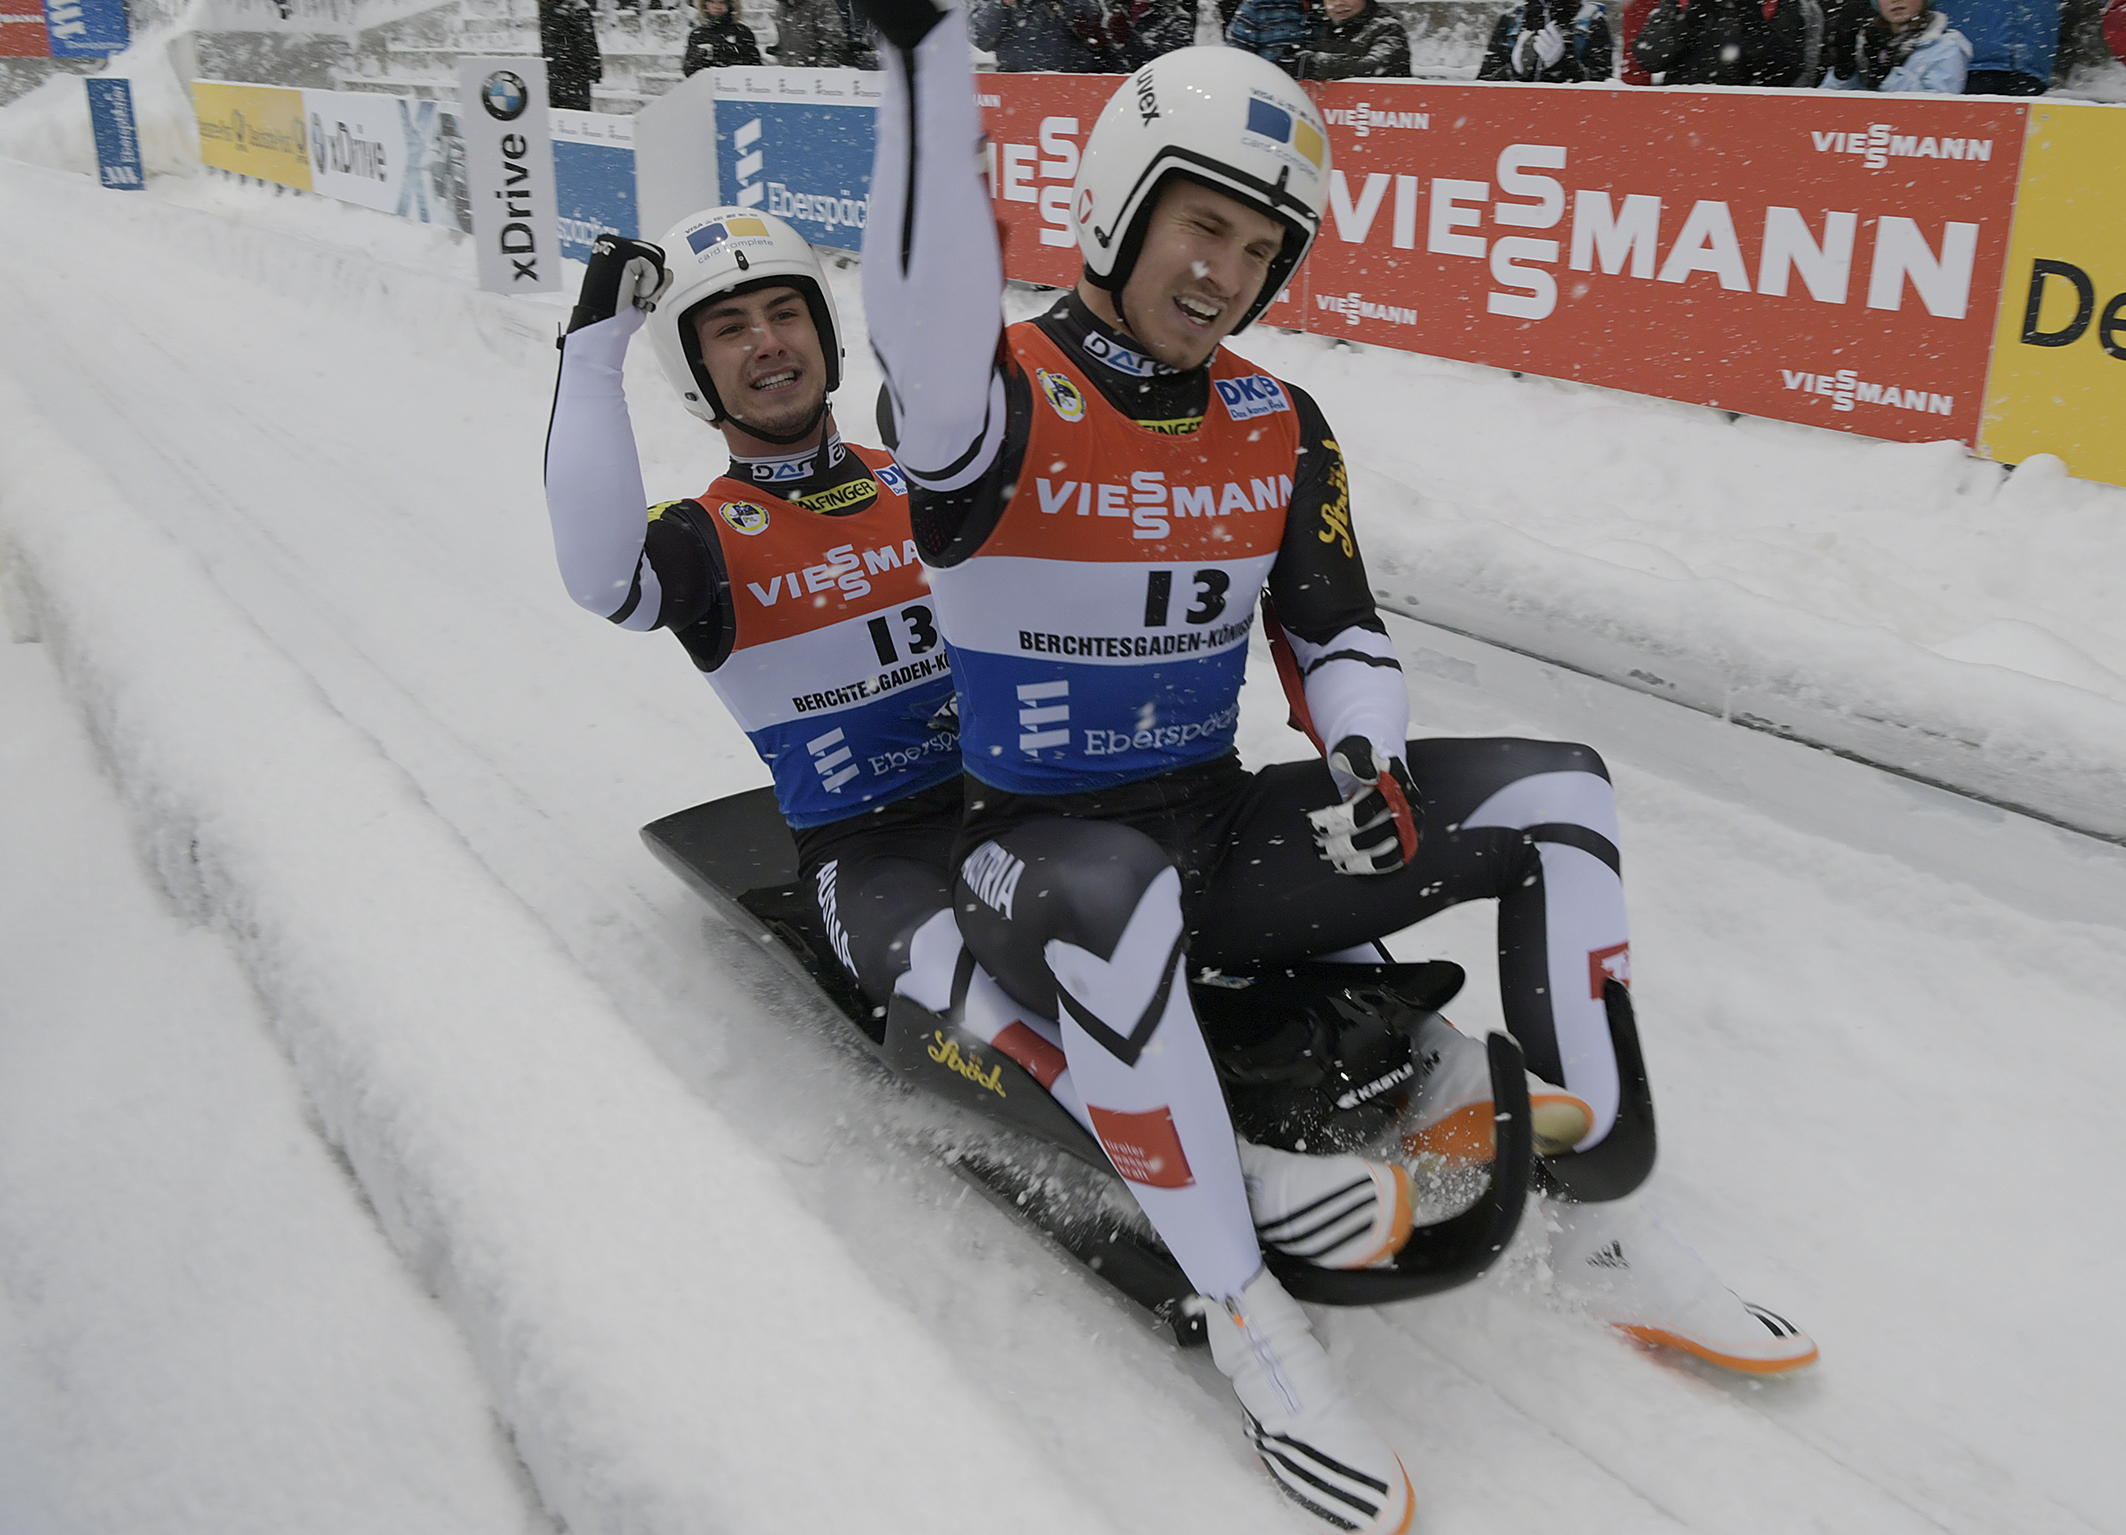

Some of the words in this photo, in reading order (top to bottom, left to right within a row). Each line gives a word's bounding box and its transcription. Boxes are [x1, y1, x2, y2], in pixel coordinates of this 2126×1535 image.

[1136, 68, 1161, 128] uvex
[1324, 102, 1430, 138] VIESSMANN
[1811, 124, 1993, 170] VIESSMANN
[496, 133, 540, 282] xDrive
[767, 182, 869, 232] Eberspäc
[1328, 143, 1980, 320] VIESSMANN
[697, 247, 722, 264] card
[724, 237, 774, 251] complete
[1315, 291, 1418, 326] VIESSMANN
[1215, 375, 1279, 406] DKB
[1782, 368, 1953, 416] VIESSMANN
[797, 481, 875, 512] ALFINGER
[747, 539, 920, 607] VIESSMA
[1144, 569, 1230, 628] 13
[867, 604, 938, 667] 13
